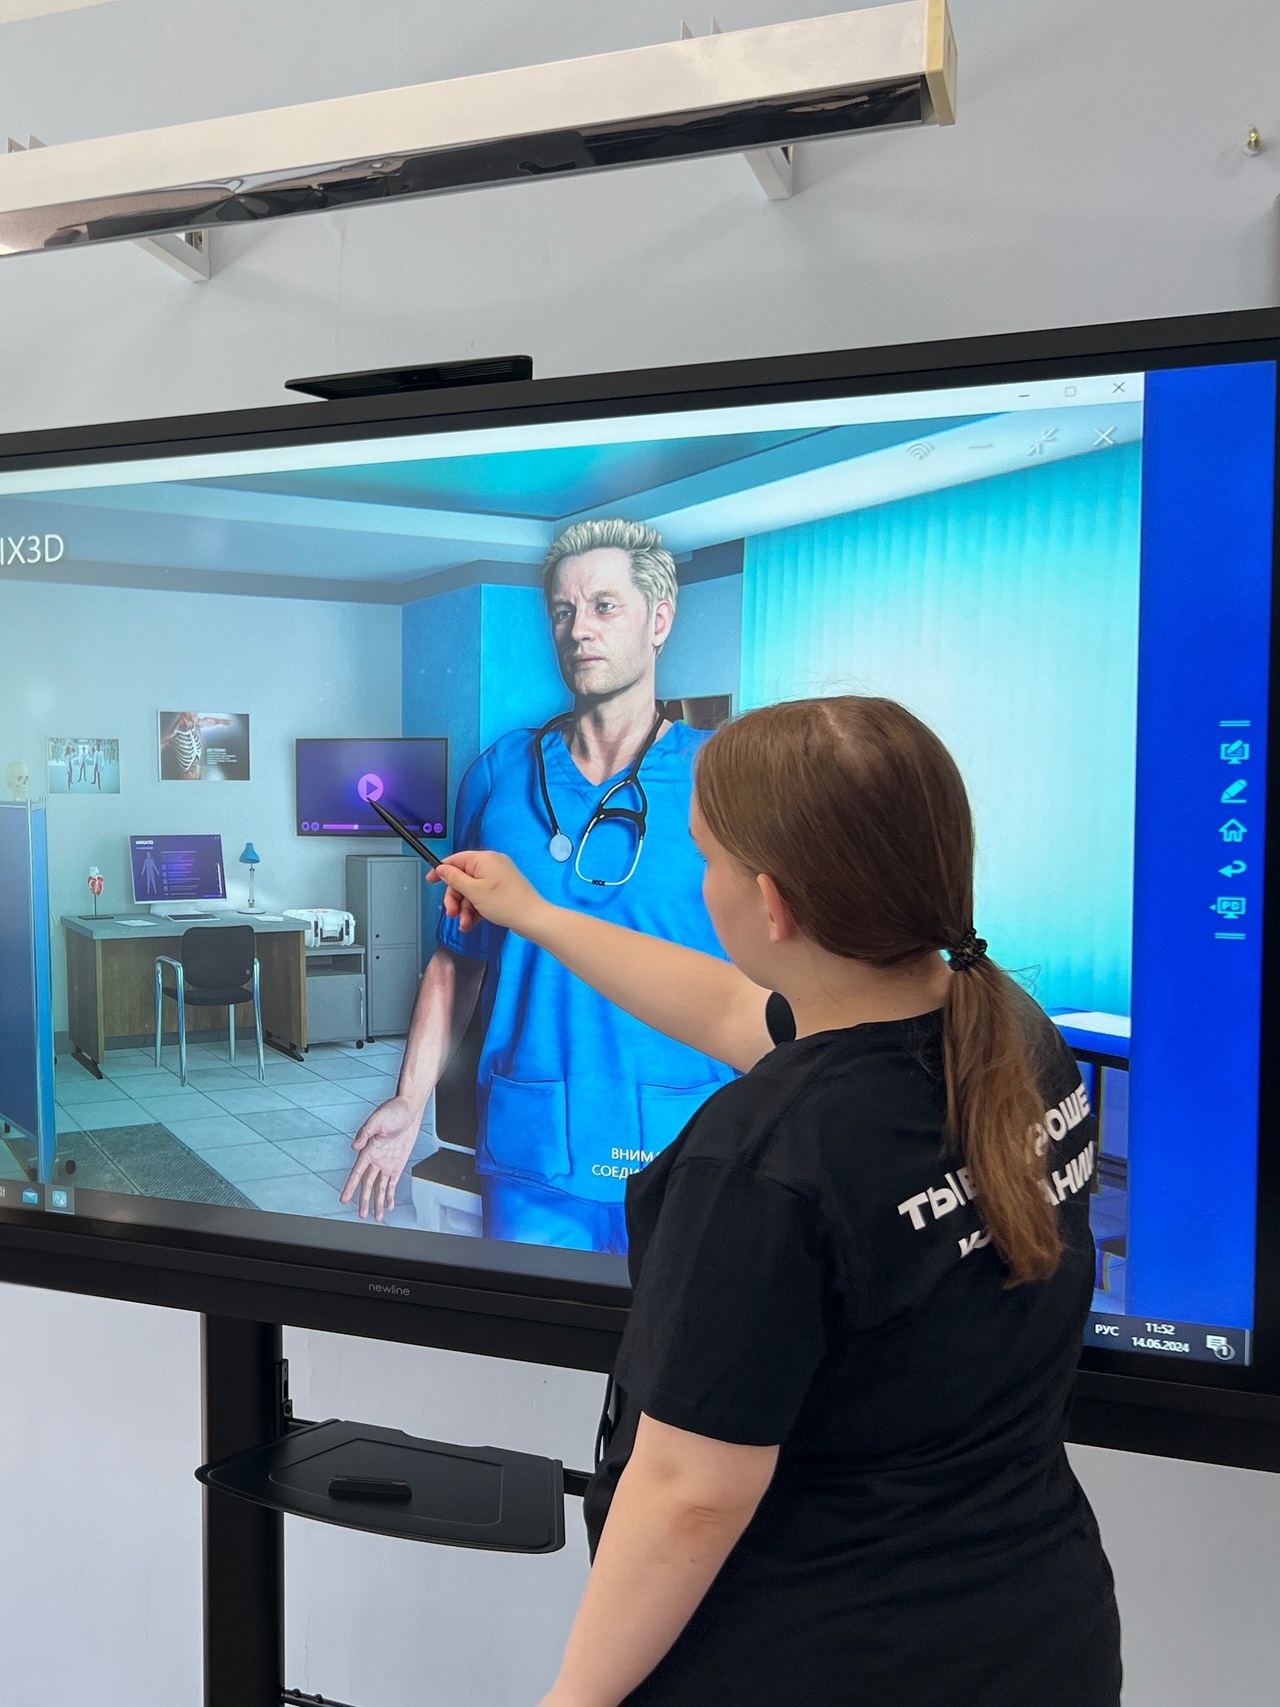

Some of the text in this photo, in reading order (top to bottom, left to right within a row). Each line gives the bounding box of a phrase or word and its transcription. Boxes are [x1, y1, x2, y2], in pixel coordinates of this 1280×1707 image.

[1221, 901, 1240, 911] PC
[611, 1147, 661, 1162] ВНИМ
[368, 1283, 411, 1297] newline
[1094, 1323, 1120, 1337] РУС
[1145, 1322, 1176, 1336] 11:52
[1131, 1336, 1190, 1353] 14.06.2024
